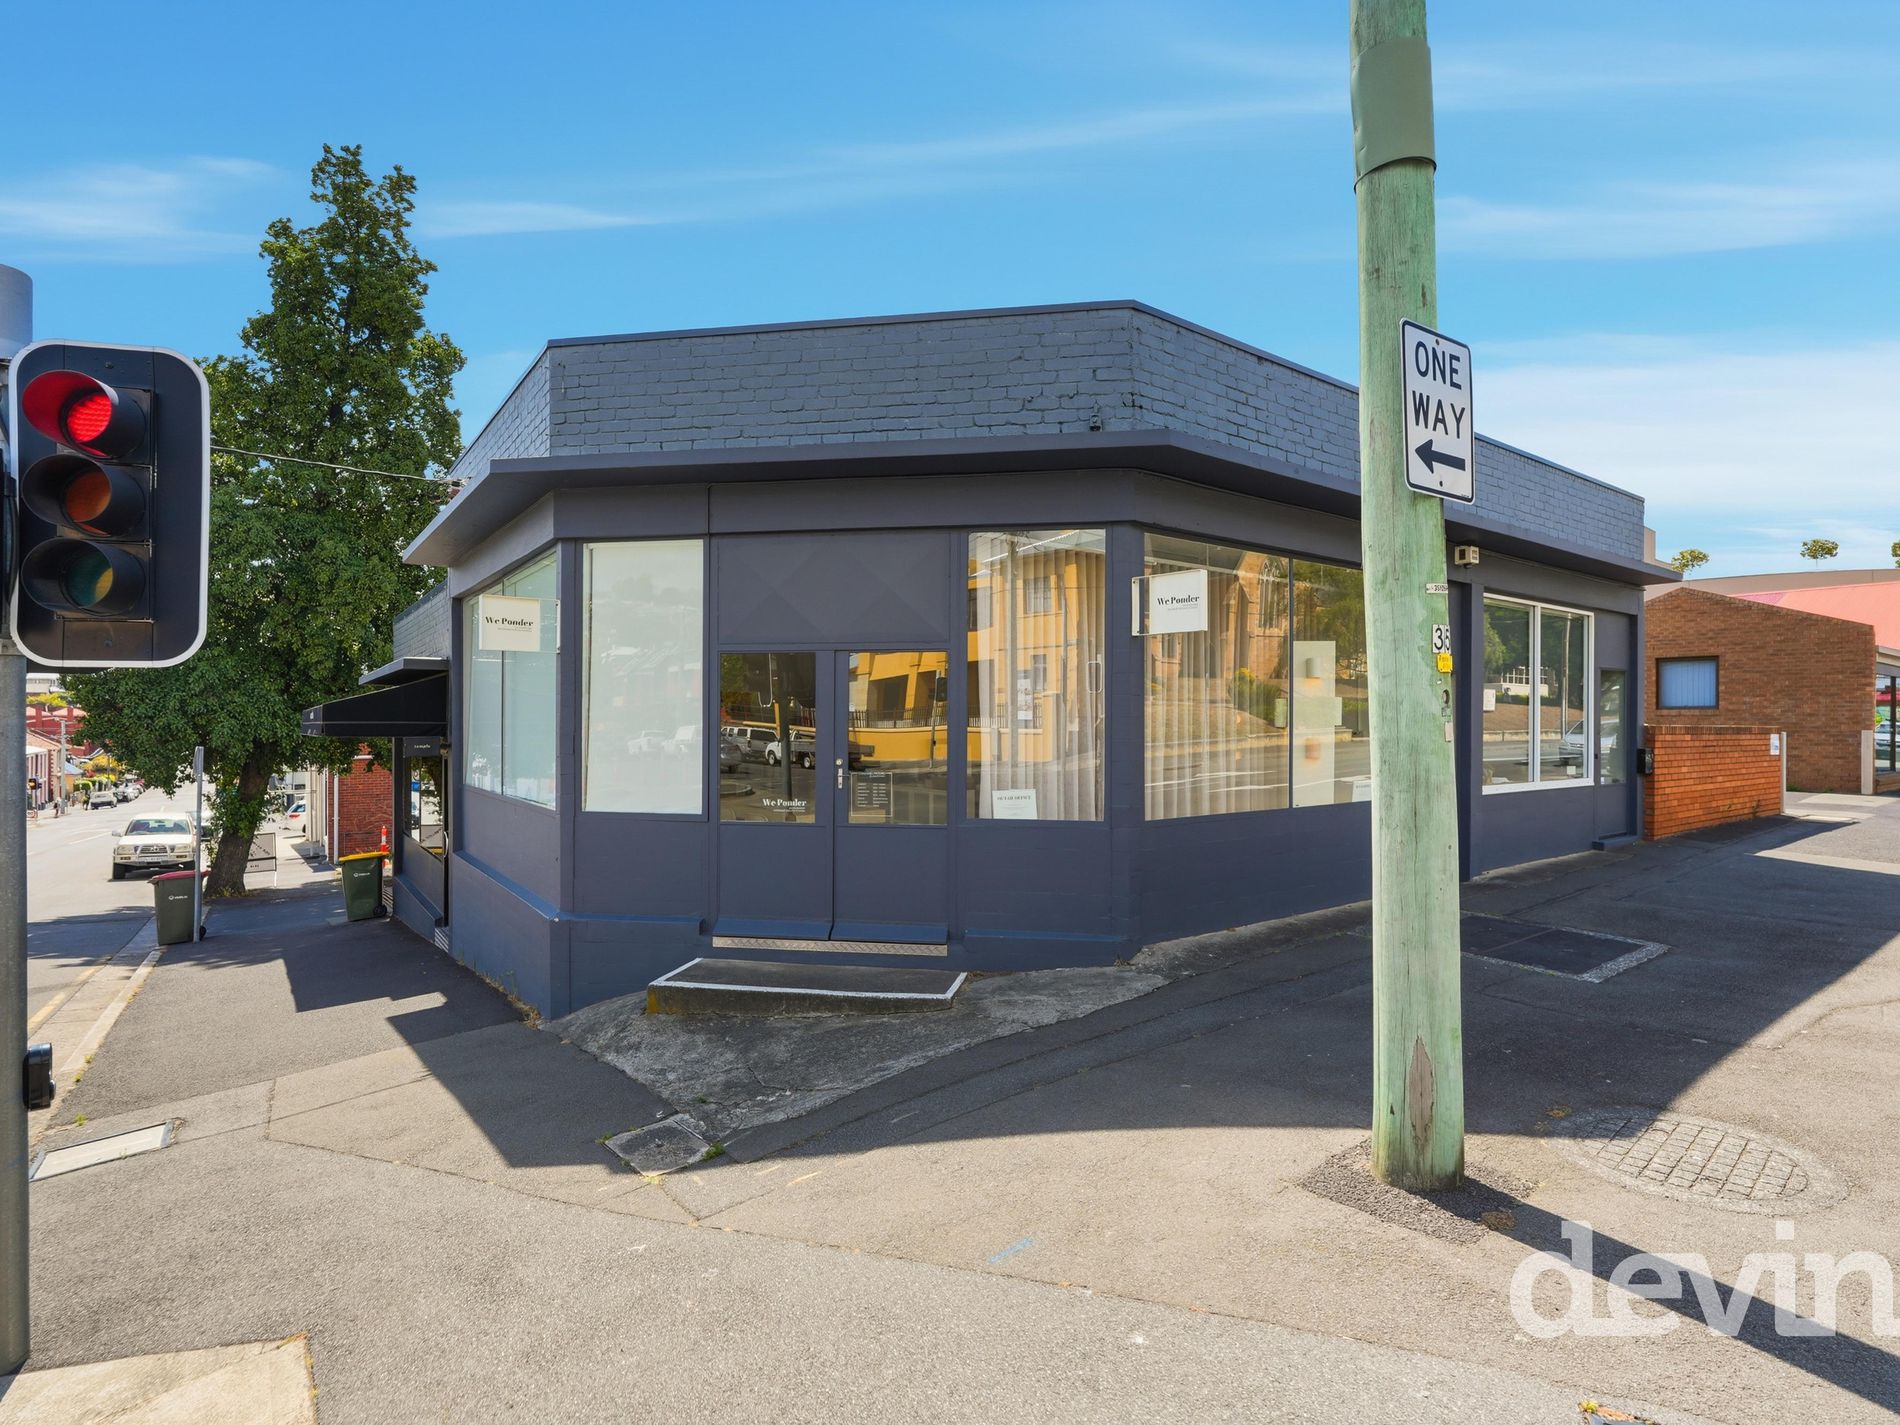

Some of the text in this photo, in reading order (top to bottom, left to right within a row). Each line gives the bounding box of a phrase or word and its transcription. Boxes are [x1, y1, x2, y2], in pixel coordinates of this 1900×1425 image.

[1414, 340, 1462, 390] ONE
[1412, 390, 1466, 439] WAY
[1157, 594, 1200, 606] We Ponder
[485, 616, 534, 627] We Ponder
[762, 798, 807, 807] We Ponder
